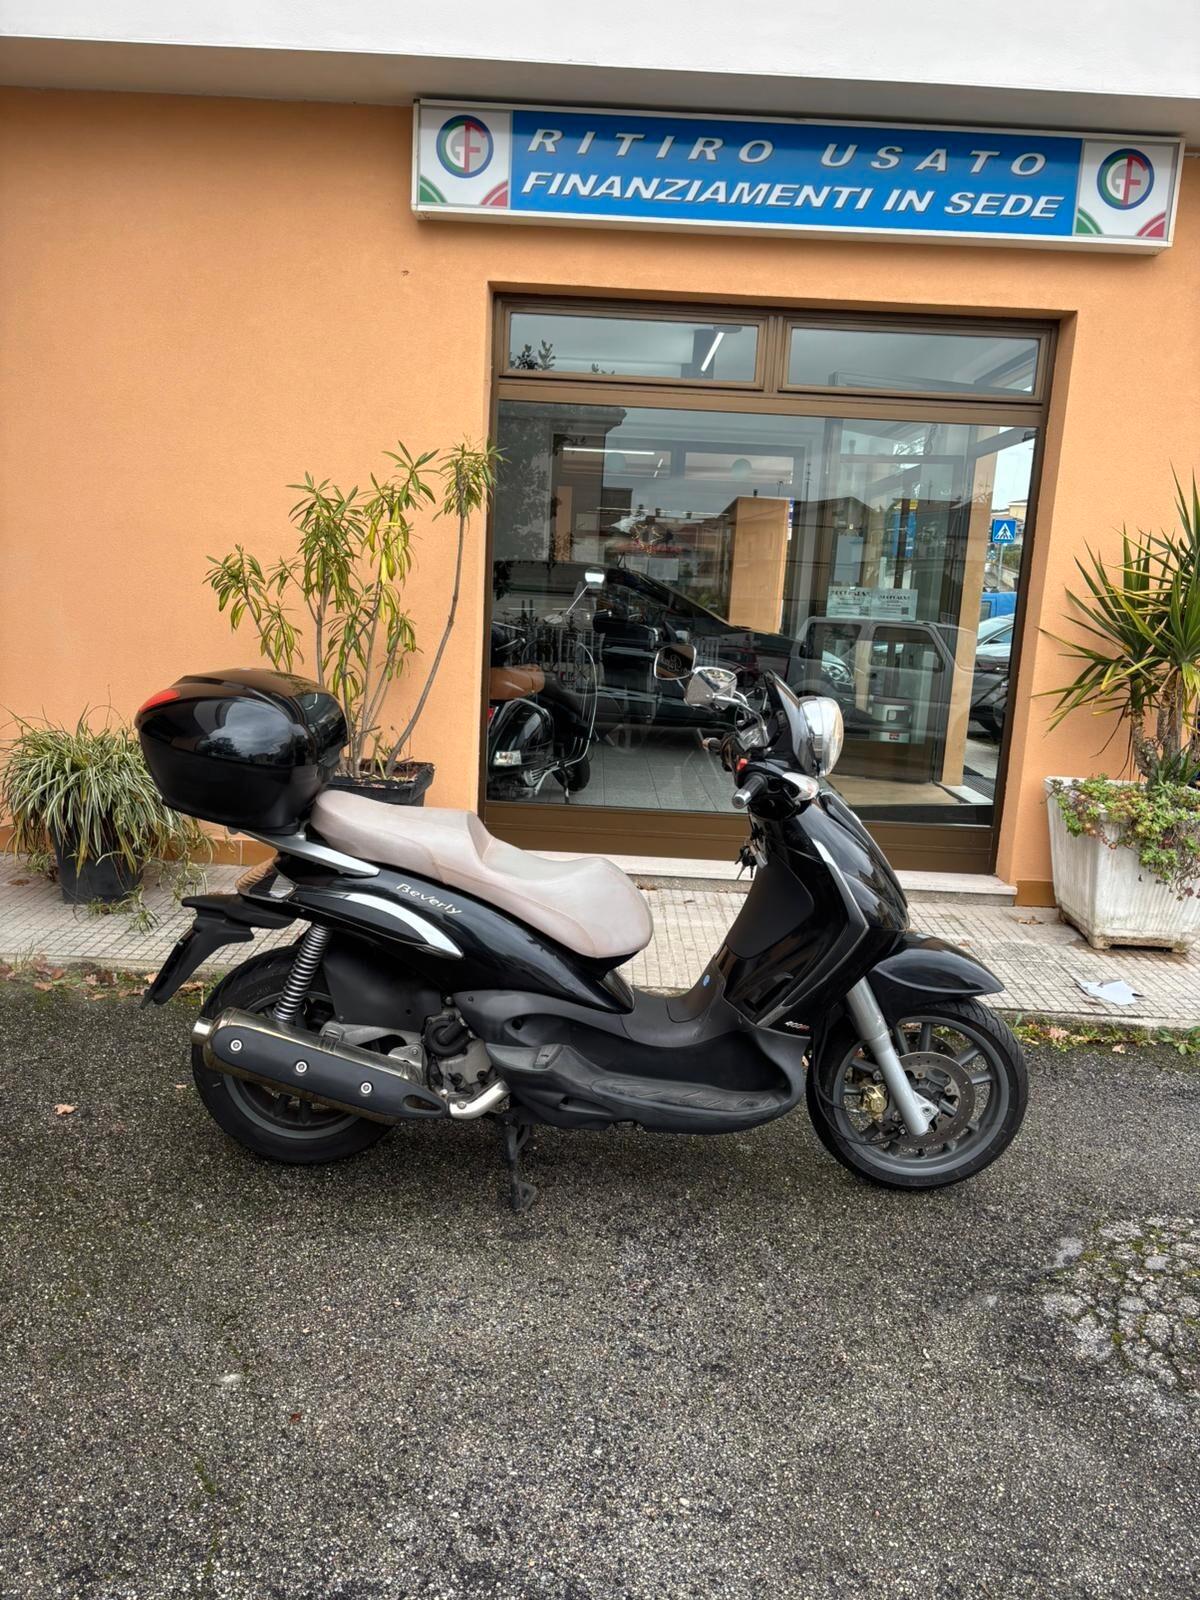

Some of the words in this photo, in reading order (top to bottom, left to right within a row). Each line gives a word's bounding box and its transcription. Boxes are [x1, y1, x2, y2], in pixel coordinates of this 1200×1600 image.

[527, 128, 775, 164] RITIRO
[820, 143, 1047, 177] USATO
[521, 171, 873, 211] FINANZIAMENTI
[883, 188, 934, 213] IN
[944, 191, 1065, 219] SEDE
[396, 883, 462, 914] Beverly
